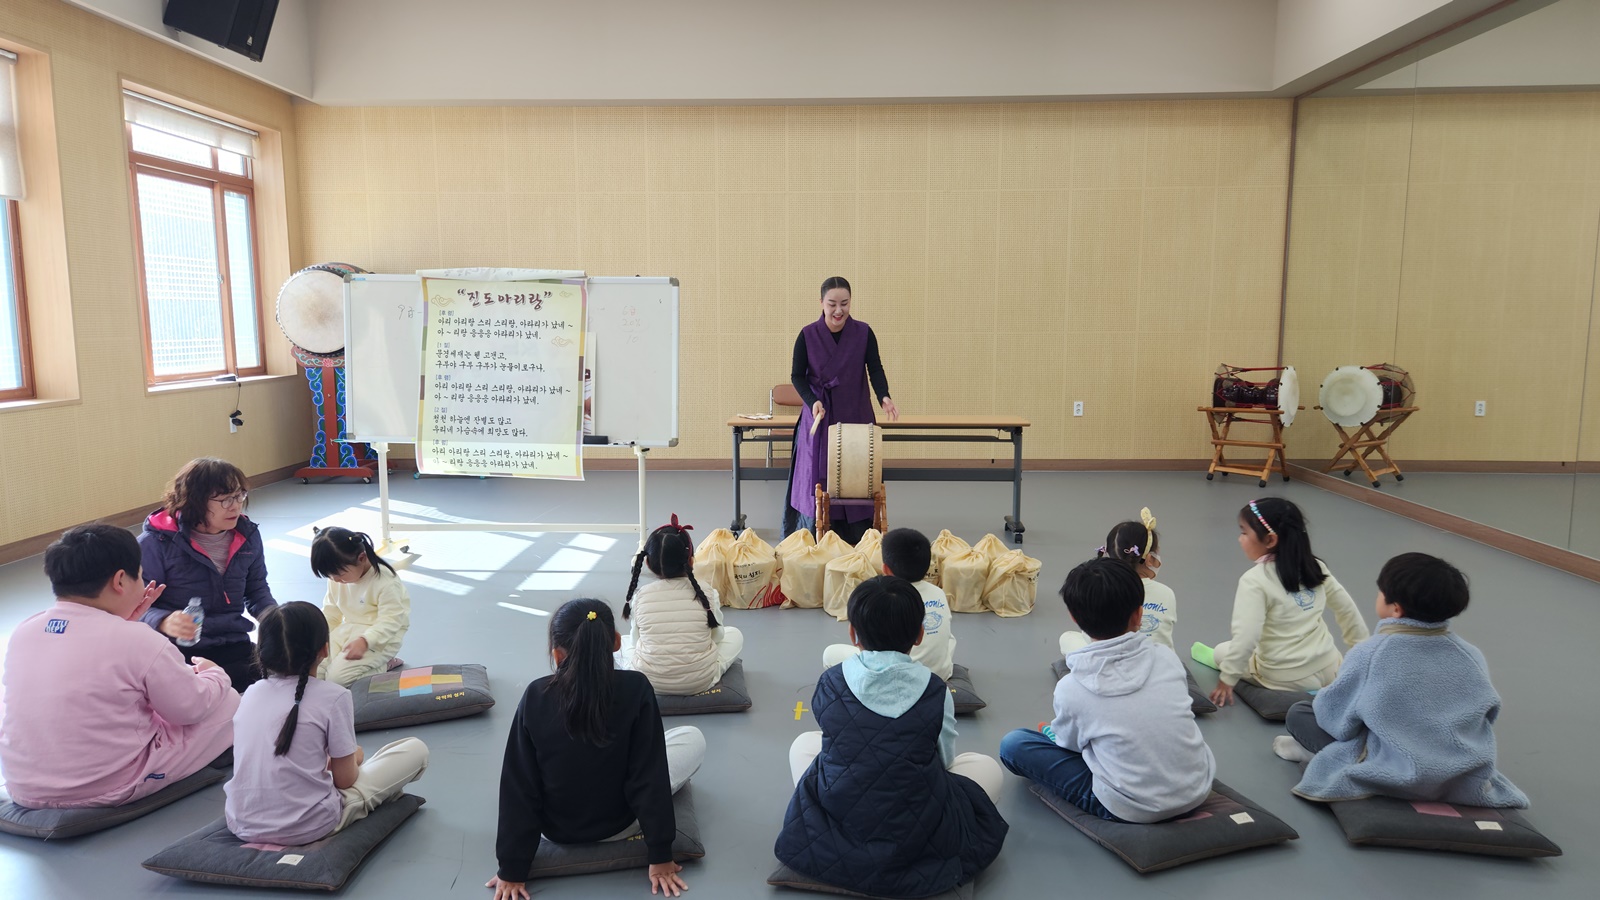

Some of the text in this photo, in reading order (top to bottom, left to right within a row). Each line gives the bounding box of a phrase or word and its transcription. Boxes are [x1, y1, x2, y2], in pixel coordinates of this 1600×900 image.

[438, 317, 452, 326] 아리
[454, 318, 475, 326] 아리랑
[478, 318, 491, 327] 스리
[520, 320, 548, 329] 아라리가
[550, 321, 565, 329] 났네
[454, 328, 468, 337] 리랑
[470, 328, 492, 338] 응응응
[494, 330, 522, 339] 아라리가
[459, 361, 474, 370] 구부
[434, 382, 448, 390] 아리
[450, 382, 472, 392] 아리랑
[474, 383, 488, 392] 스리
[518, 384, 546, 394] 아라리가
[548, 386, 563, 394] 났네
[450, 393, 465, 402] 리랑
[467, 394, 489, 404] 응응응
[491, 394, 520, 404] 아라리가
[432, 448, 446, 456] 아리
[448, 448, 470, 457] 아리랑
[472, 448, 486, 457] 스리
[515, 450, 544, 460] 아라리가
[546, 451, 560, 460] 났네
[450, 458, 463, 467] 리랑
[466, 459, 488, 468] 응응응
[490, 460, 518, 469] 아라리가
